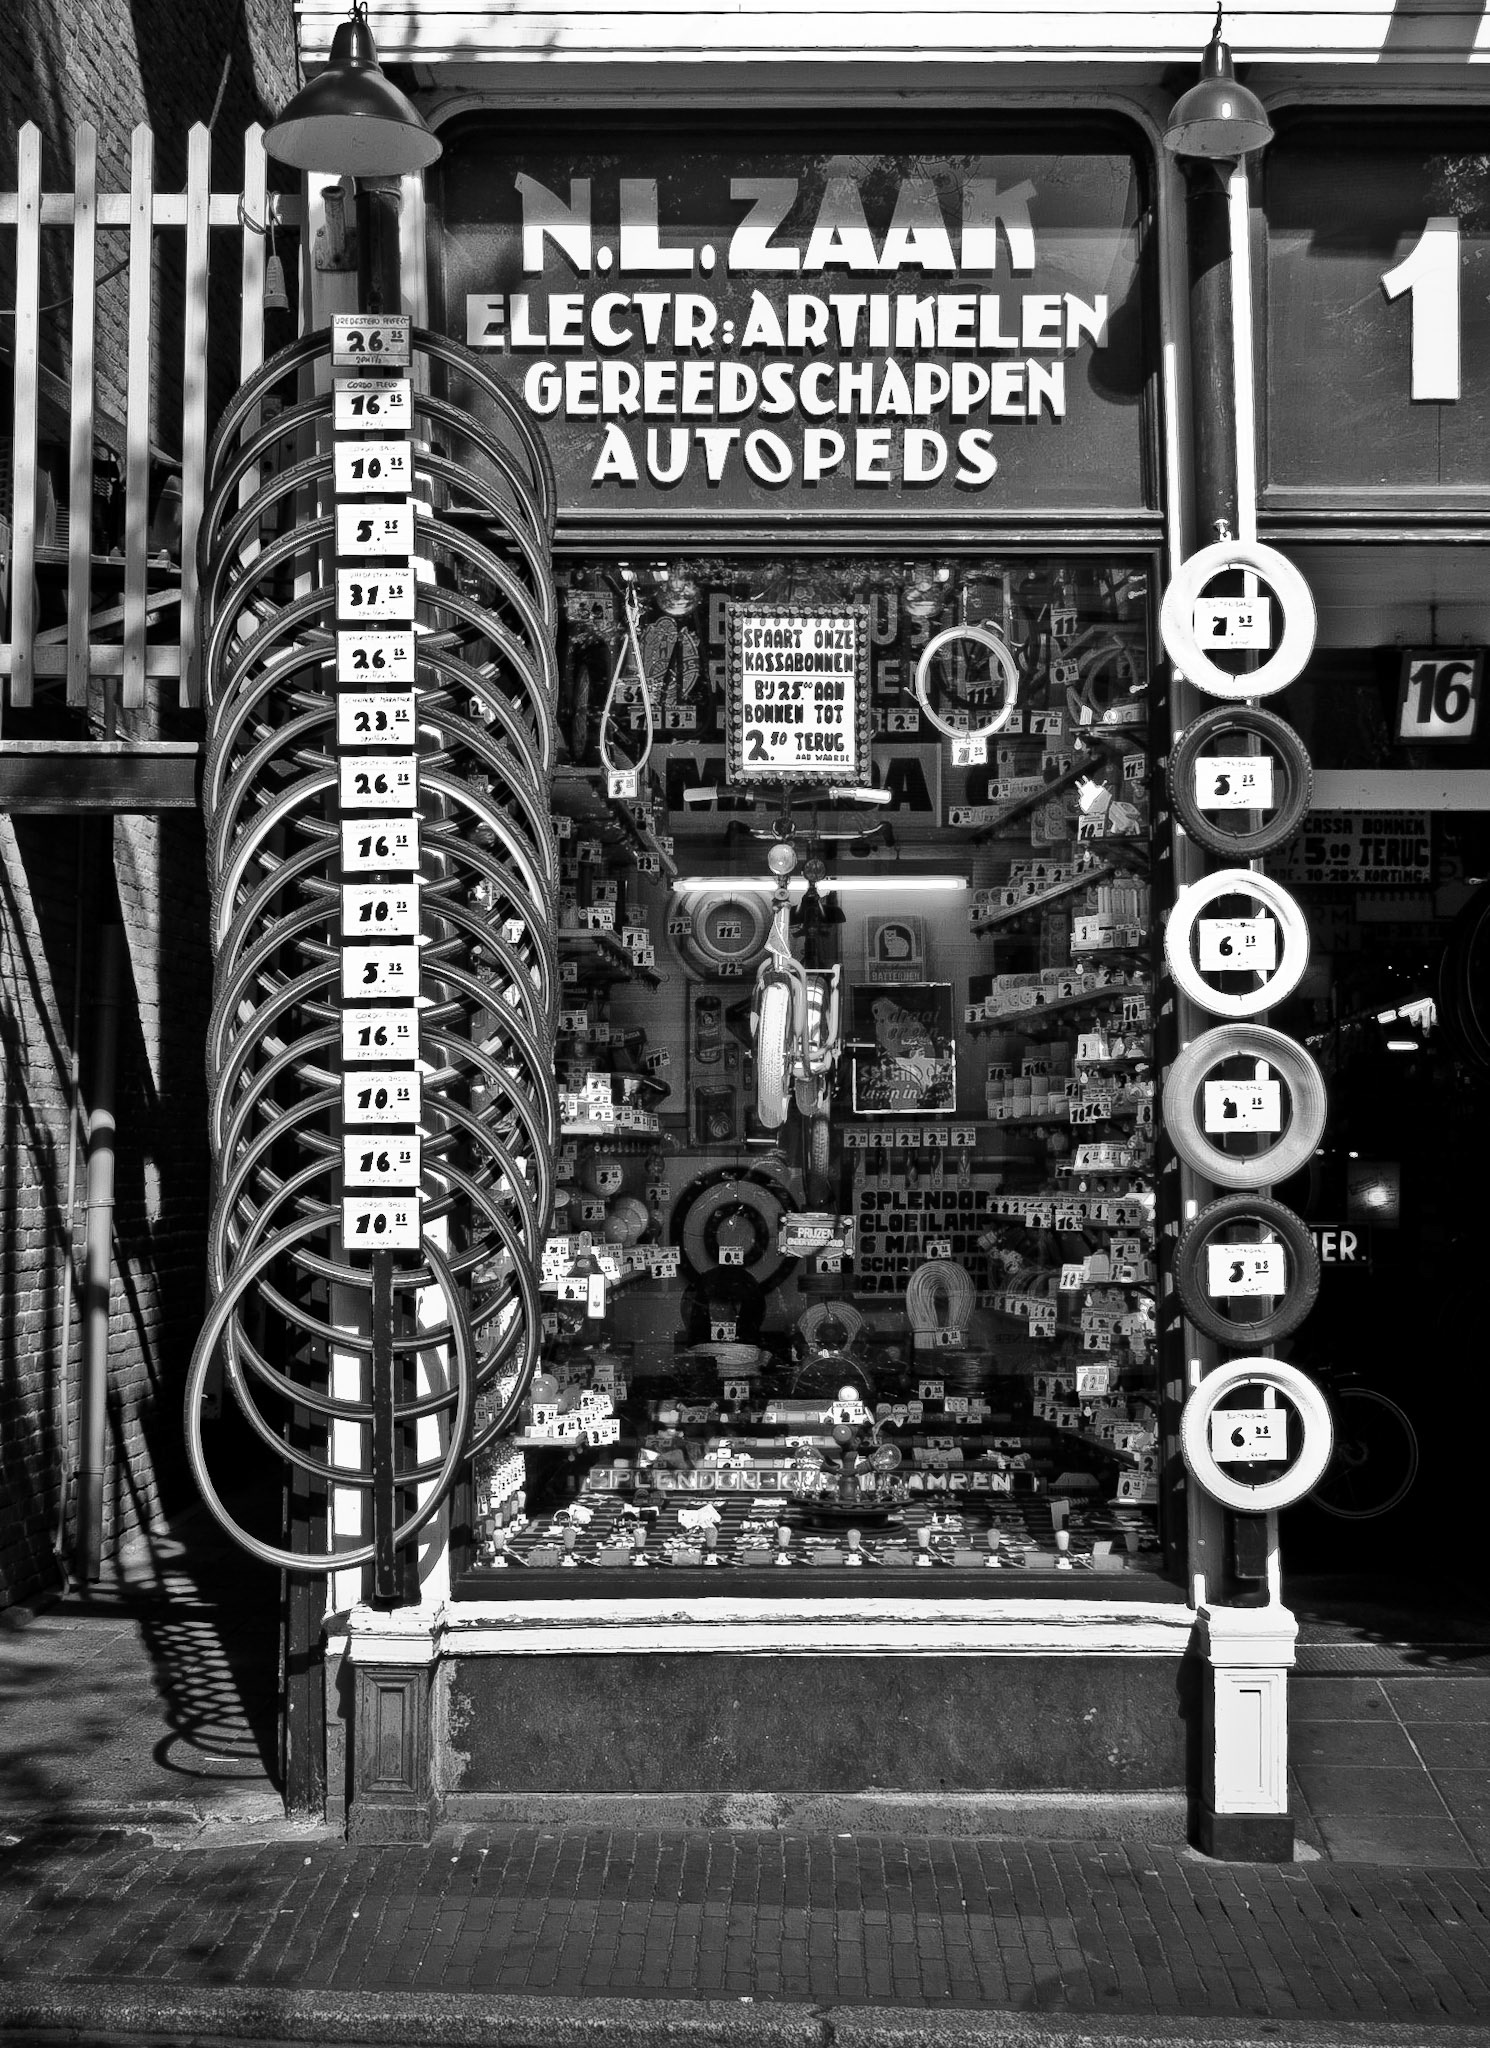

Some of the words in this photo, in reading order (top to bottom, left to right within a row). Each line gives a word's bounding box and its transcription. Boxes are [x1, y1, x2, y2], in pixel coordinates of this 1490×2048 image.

[1381, 216, 1460, 400] 1
[523, 357, 1066, 417] GEREEDSCHAPPEN
[591, 422, 998, 485] AUTOPEDS
[744, 628, 803, 649] SPAART
[814, 628, 854, 650] ONZE
[745, 652, 854, 672] KASSABONNEN
[1410, 662, 1474, 724] 16
[744, 703, 804, 724] BONNEN
[814, 704, 844, 724] TOT
[794, 732, 845, 752] TERUG
[1303, 818, 1353, 835] CASSA
[1359, 838, 1430, 866] TERUG
[860, 1190, 989, 1210] SPLENDOR
[797, 1227, 835, 1239] PRIJZEN
